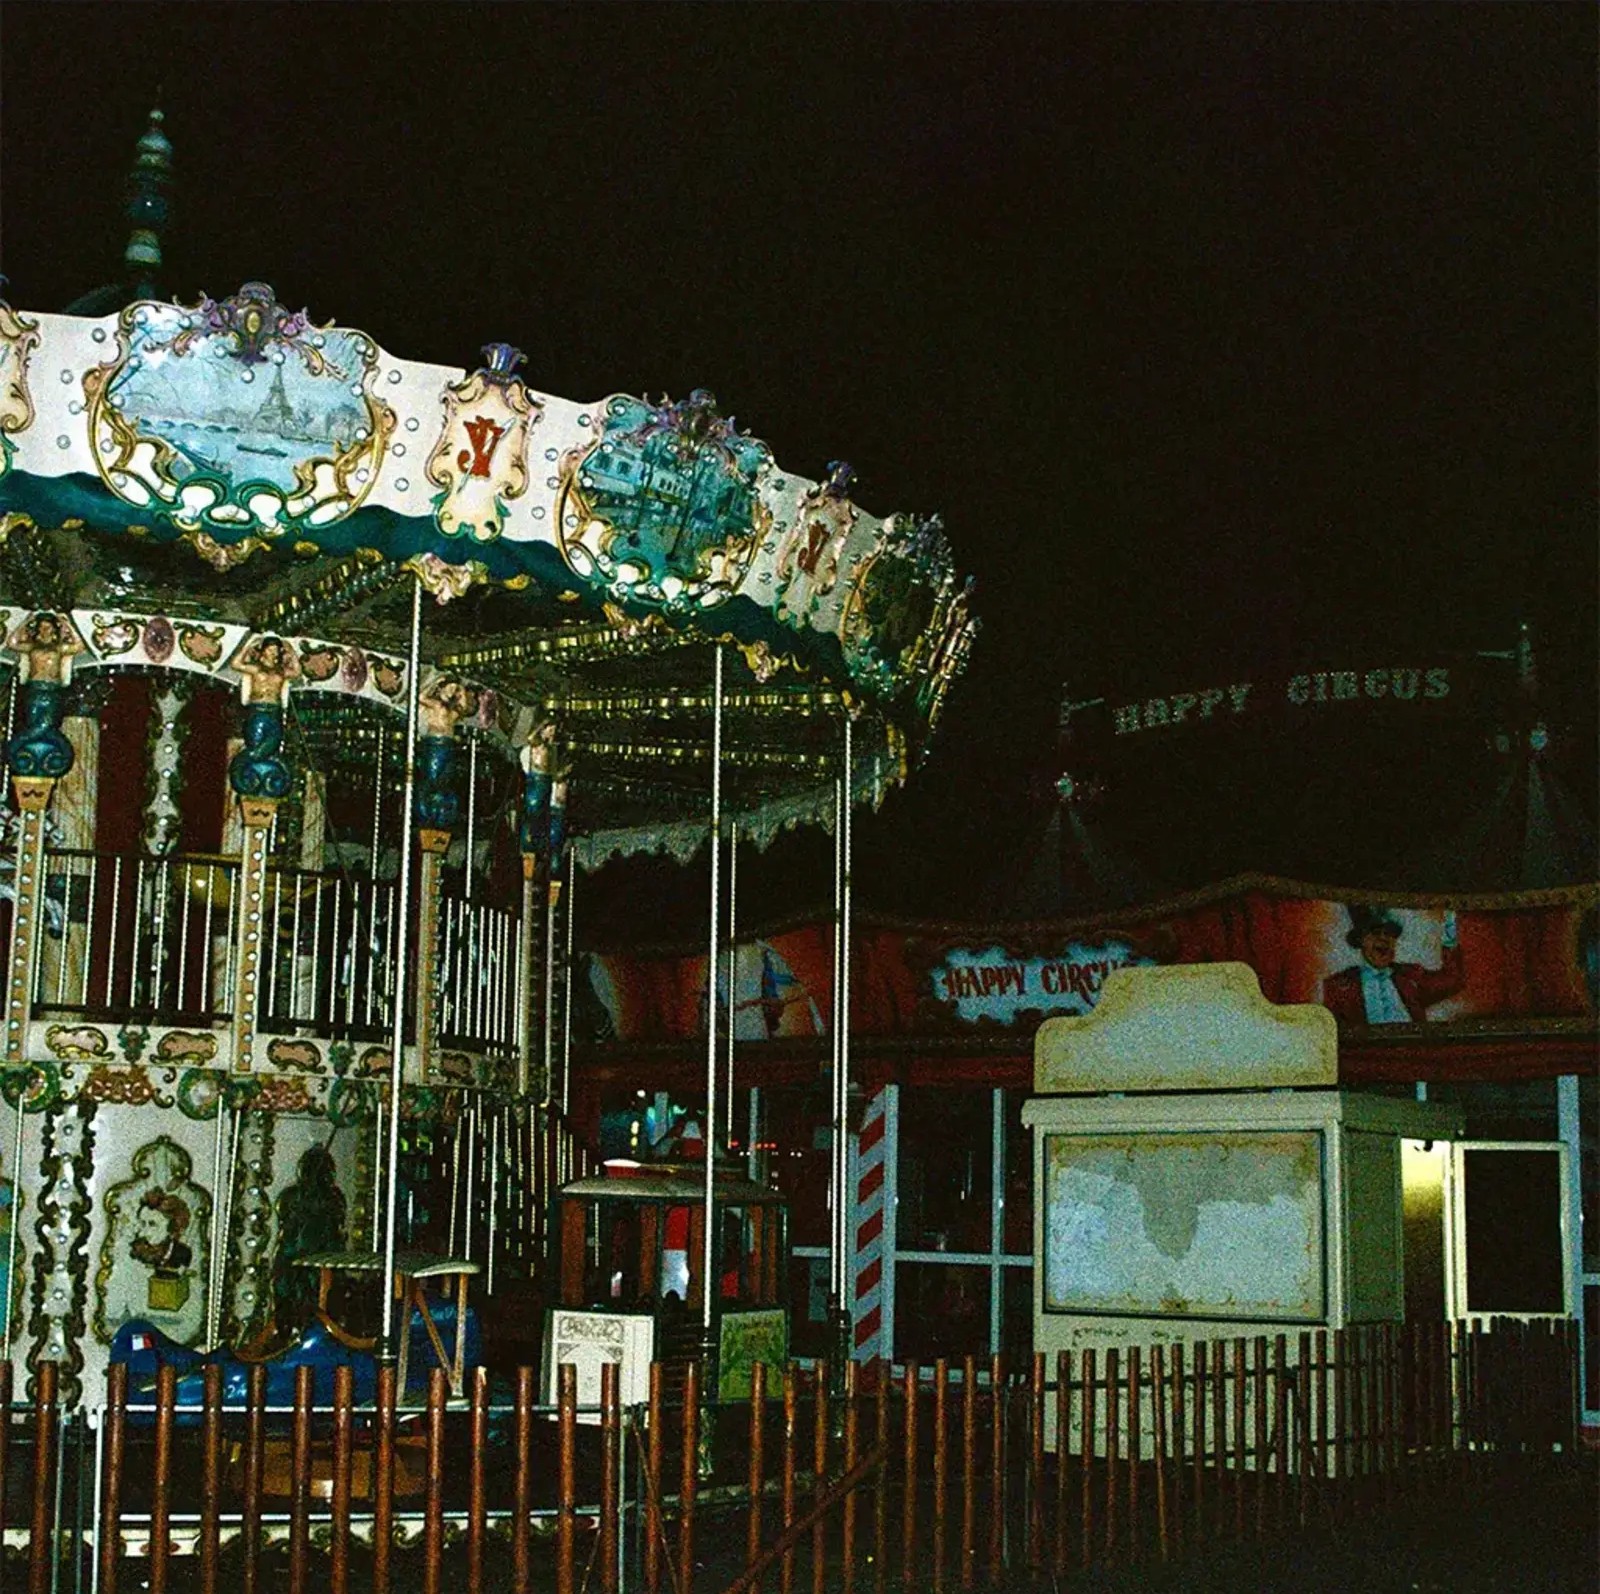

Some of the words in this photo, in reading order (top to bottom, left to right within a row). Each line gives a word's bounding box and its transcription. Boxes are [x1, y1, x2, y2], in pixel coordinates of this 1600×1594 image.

[1113, 683, 1252, 735] HAPPY
[1287, 668, 1450, 705] CIRCUS
[942, 964, 1025, 997] HAPPY
[1041, 960, 1136, 1007] CIRC
